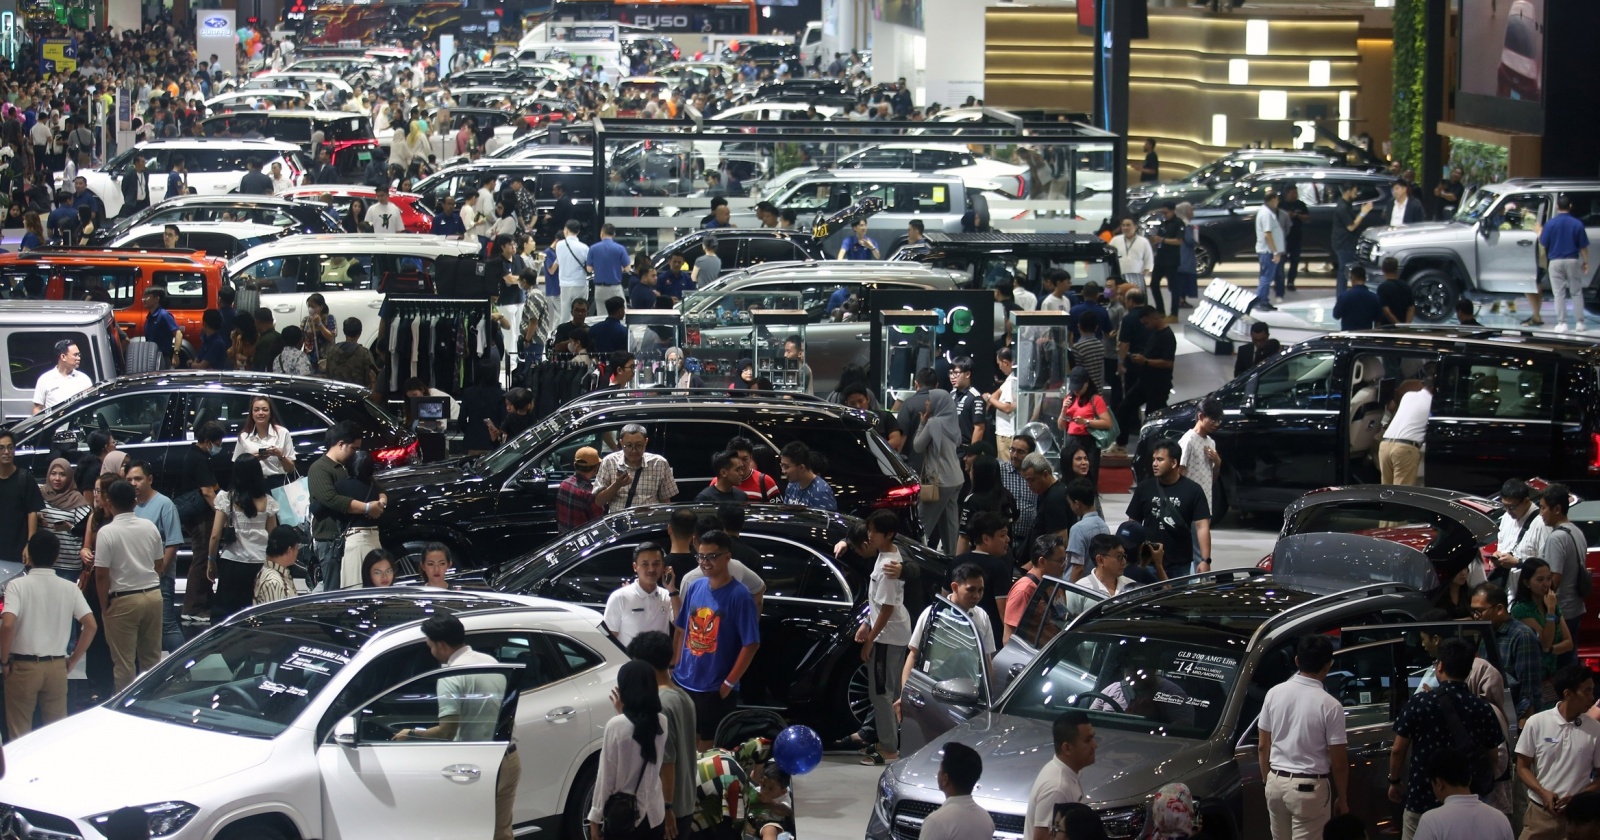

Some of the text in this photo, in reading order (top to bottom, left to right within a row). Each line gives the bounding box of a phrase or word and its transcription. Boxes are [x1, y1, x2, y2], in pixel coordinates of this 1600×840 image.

[634, 16, 688, 27] FUSO
[1220, 284, 1258, 313] TANK
[1200, 305, 1234, 336] DIESEL
[1177, 662, 1194, 673] 14
[1185, 696, 1193, 705] 2
